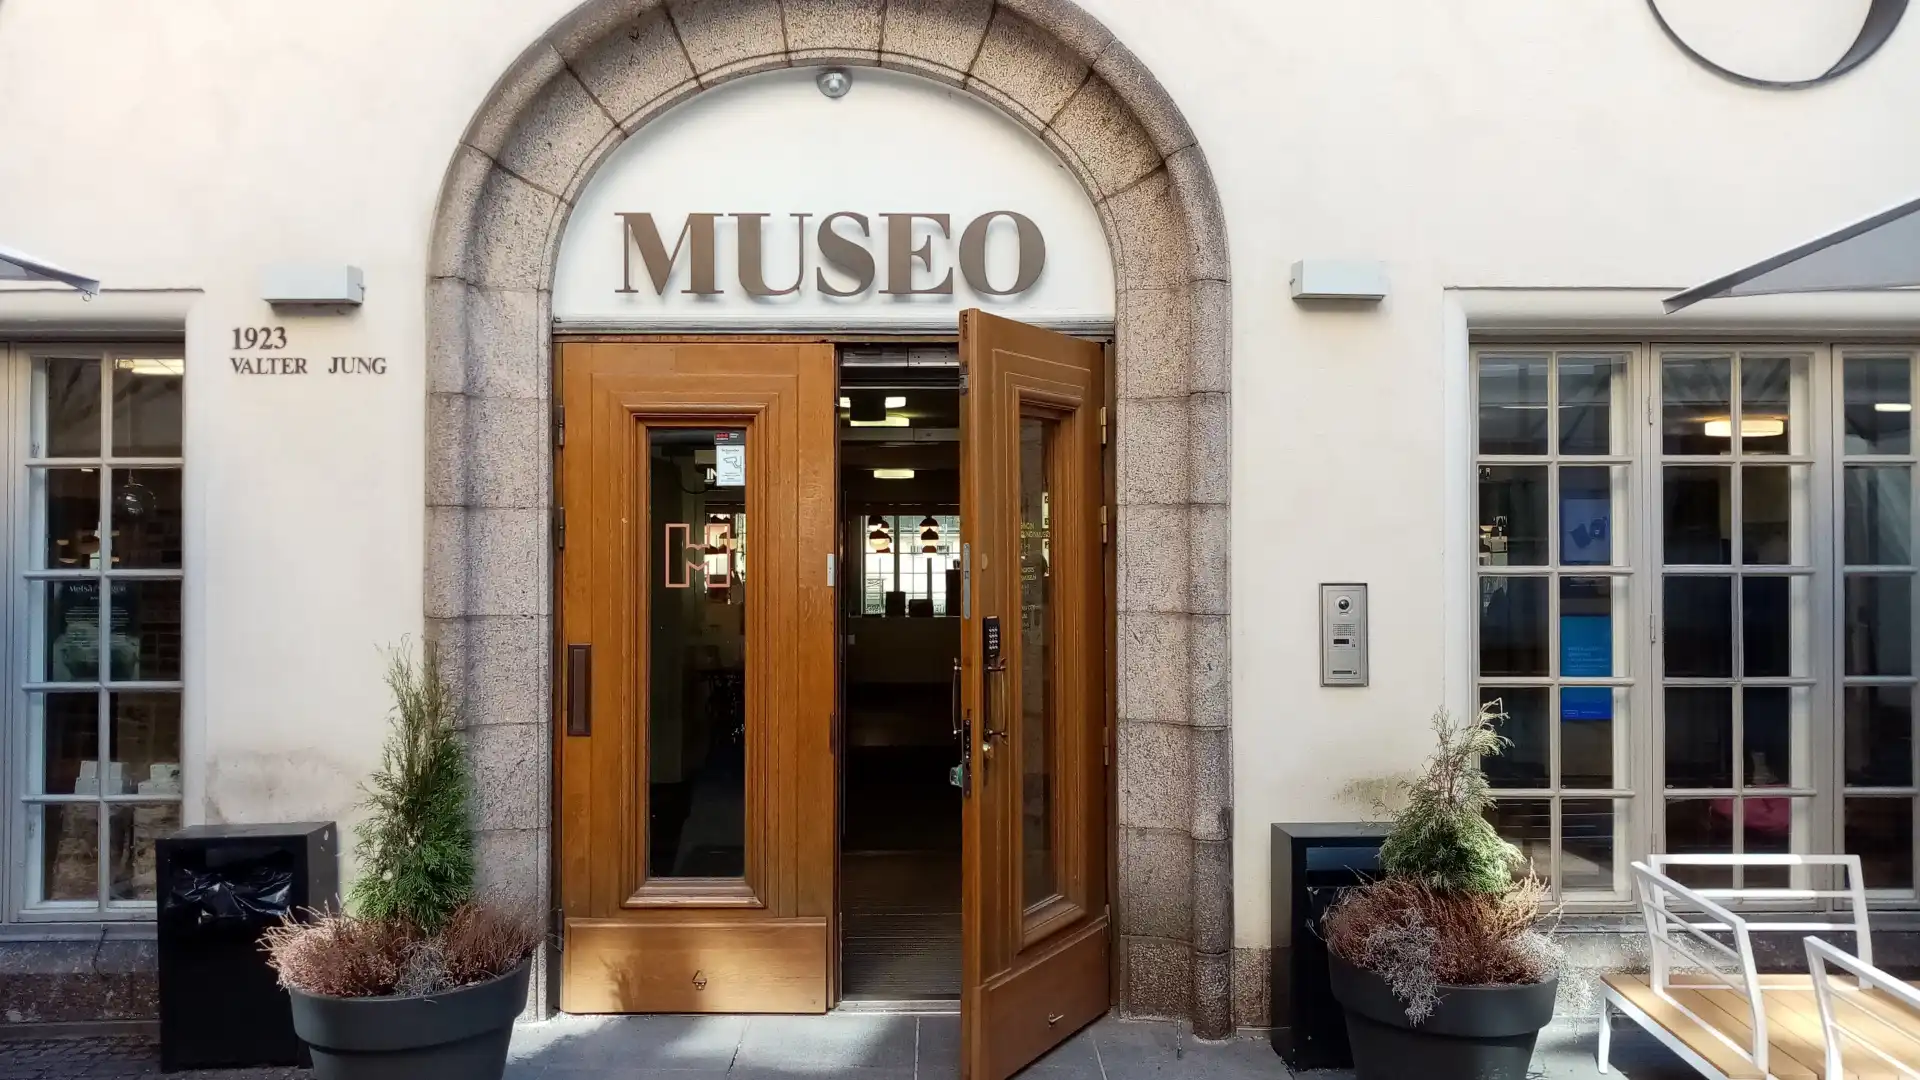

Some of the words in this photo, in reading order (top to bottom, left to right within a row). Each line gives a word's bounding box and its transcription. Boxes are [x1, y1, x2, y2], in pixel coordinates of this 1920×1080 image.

[614, 210, 1046, 297] MUSEO
[232, 326, 287, 350] 1923
[230, 357, 308, 375] VALTER
[328, 356, 388, 375] JUNG
